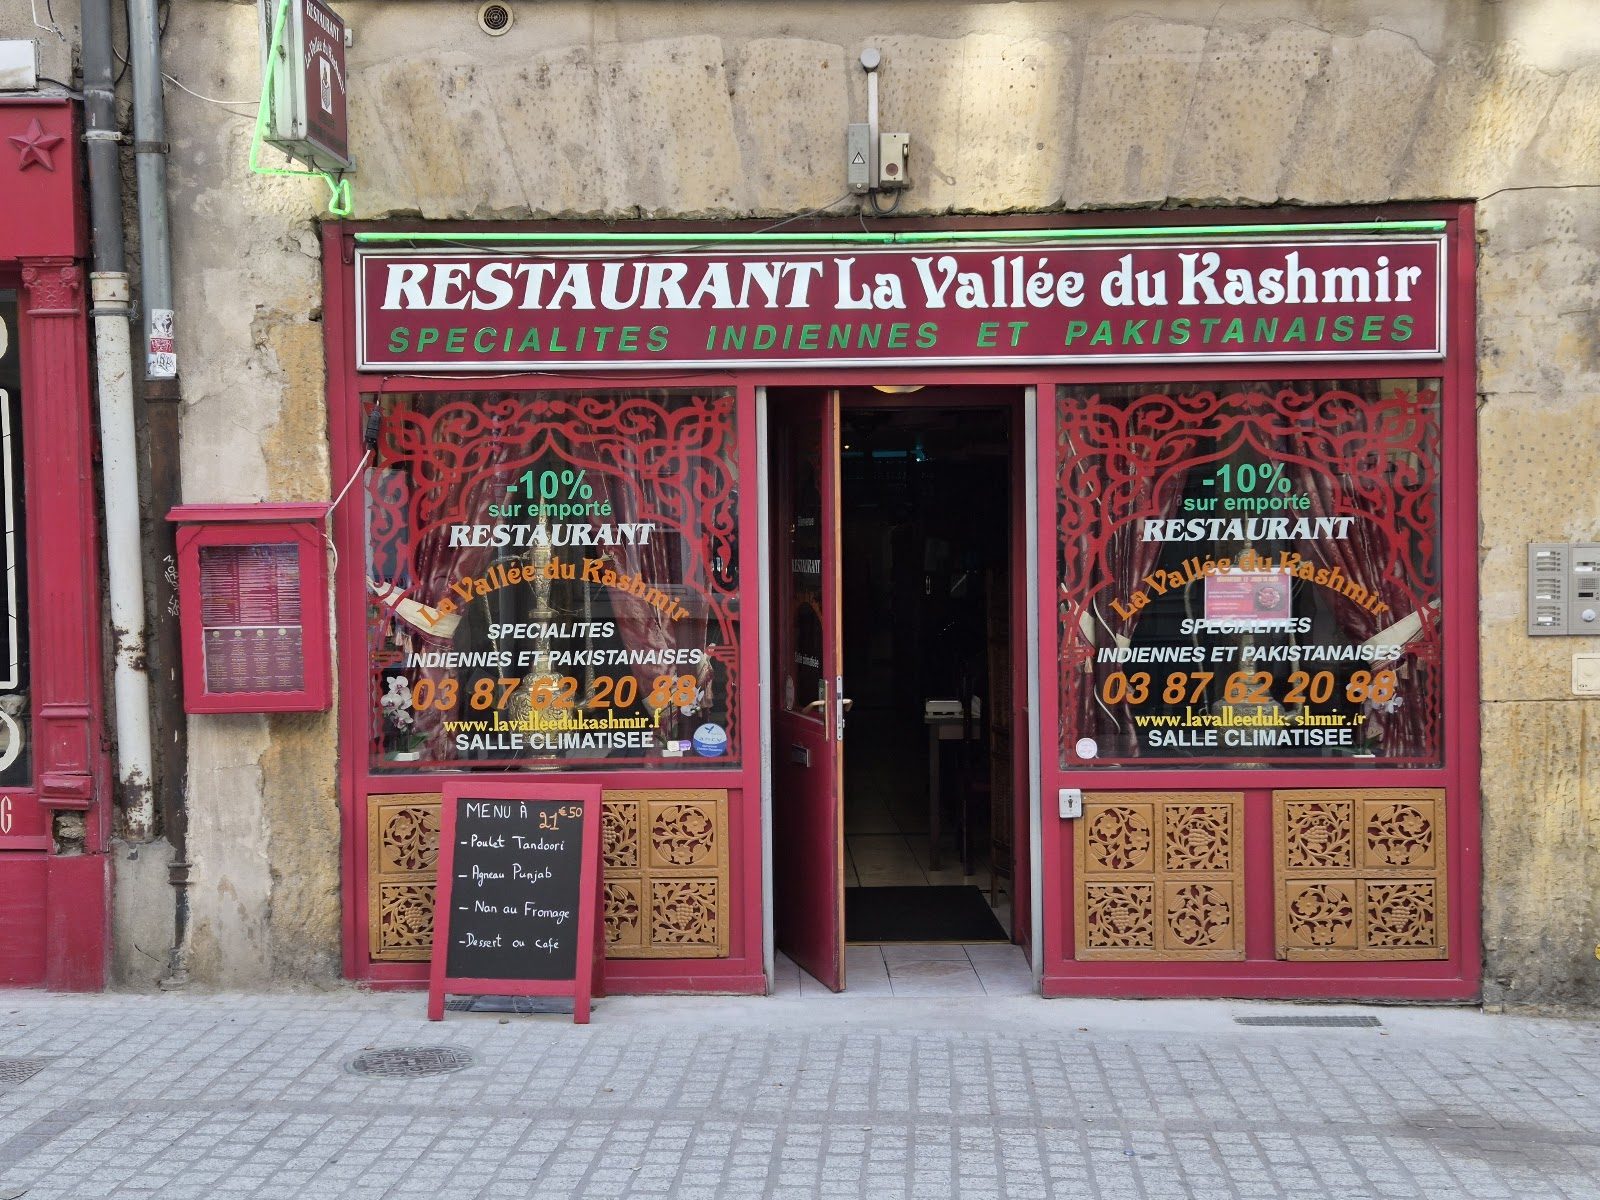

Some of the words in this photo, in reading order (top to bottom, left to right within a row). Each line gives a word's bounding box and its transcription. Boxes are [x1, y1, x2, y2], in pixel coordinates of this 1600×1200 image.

[380, 261, 824, 311] RESTAURANT
[834, 256, 906, 310] La
[911, 254, 1086, 310] Vallée
[1100, 253, 1168, 307] du
[1177, 250, 1423, 306] Kashmir
[388, 325, 670, 353] SPECIALITES
[706, 321, 939, 351] INDIENNES
[977, 321, 1029, 348] ET
[1064, 314, 1415, 346] PAKISTANAISES
[506, 468, 593, 500] -10%
[1202, 462, 1292, 493] -10%
[488, 503, 521, 518] sur
[527, 499, 612, 521] emporté
[1183, 497, 1217, 512] sur
[1223, 492, 1311, 514] emporté
[448, 523, 655, 548] RESTAURANT
[1140, 516, 1355, 542] RESTAURANT
[416, 598, 458, 628] La
[450, 561, 536, 603] Vallée
[543, 557, 576, 580] du
[581, 557, 690, 623] Kashmir
[1109, 591, 1151, 621] La
[1143, 554, 1231, 596] Vallée
[1239, 548, 1273, 573] du
[1279, 550, 1390, 617] Kashmir
[487, 622, 615, 640] SPECIALITES
[1180, 617, 1312, 635] SPECIALITES
[406, 651, 512, 668] INDIENNES
[517, 651, 543, 667] ET
[548, 648, 701, 667] PAKISTANAISES
[1097, 646, 1206, 663] INDIENNES
[1210, 646, 1237, 663] ET
[1241, 644, 1402, 662] PAKISTANAISES
[411, 678, 458, 711] 03
[470, 677, 521, 710] 87
[530, 676, 578, 710] 62
[587, 675, 638, 709] 20
[648, 674, 700, 708] 88
[1102, 671, 1151, 704] 03
[1162, 671, 1213, 704] 87
[1223, 670, 1274, 704] 62
[1283, 670, 1335, 703] 20
[1345, 669, 1398, 703] 88
[1135, 705, 1366, 728] www.lavalleedukshmir.r
[455, 732, 524, 750] SALLE
[530, 731, 655, 750] CLIMATISEE
[1149, 729, 1218, 747] SALLE
[1224, 728, 1353, 746] CLIMATISEE
[465, 802, 511, 819] MENU
[519, 801, 528, 818] À
[511, 835, 565, 851] Tandoori
[472, 864, 505, 887] Agneau
[512, 863, 552, 883] Punjab
[474, 900, 497, 914] Nan
[503, 905, 518, 915] au
[524, 901, 570, 925] Fromage
[512, 939, 525, 948] ou
